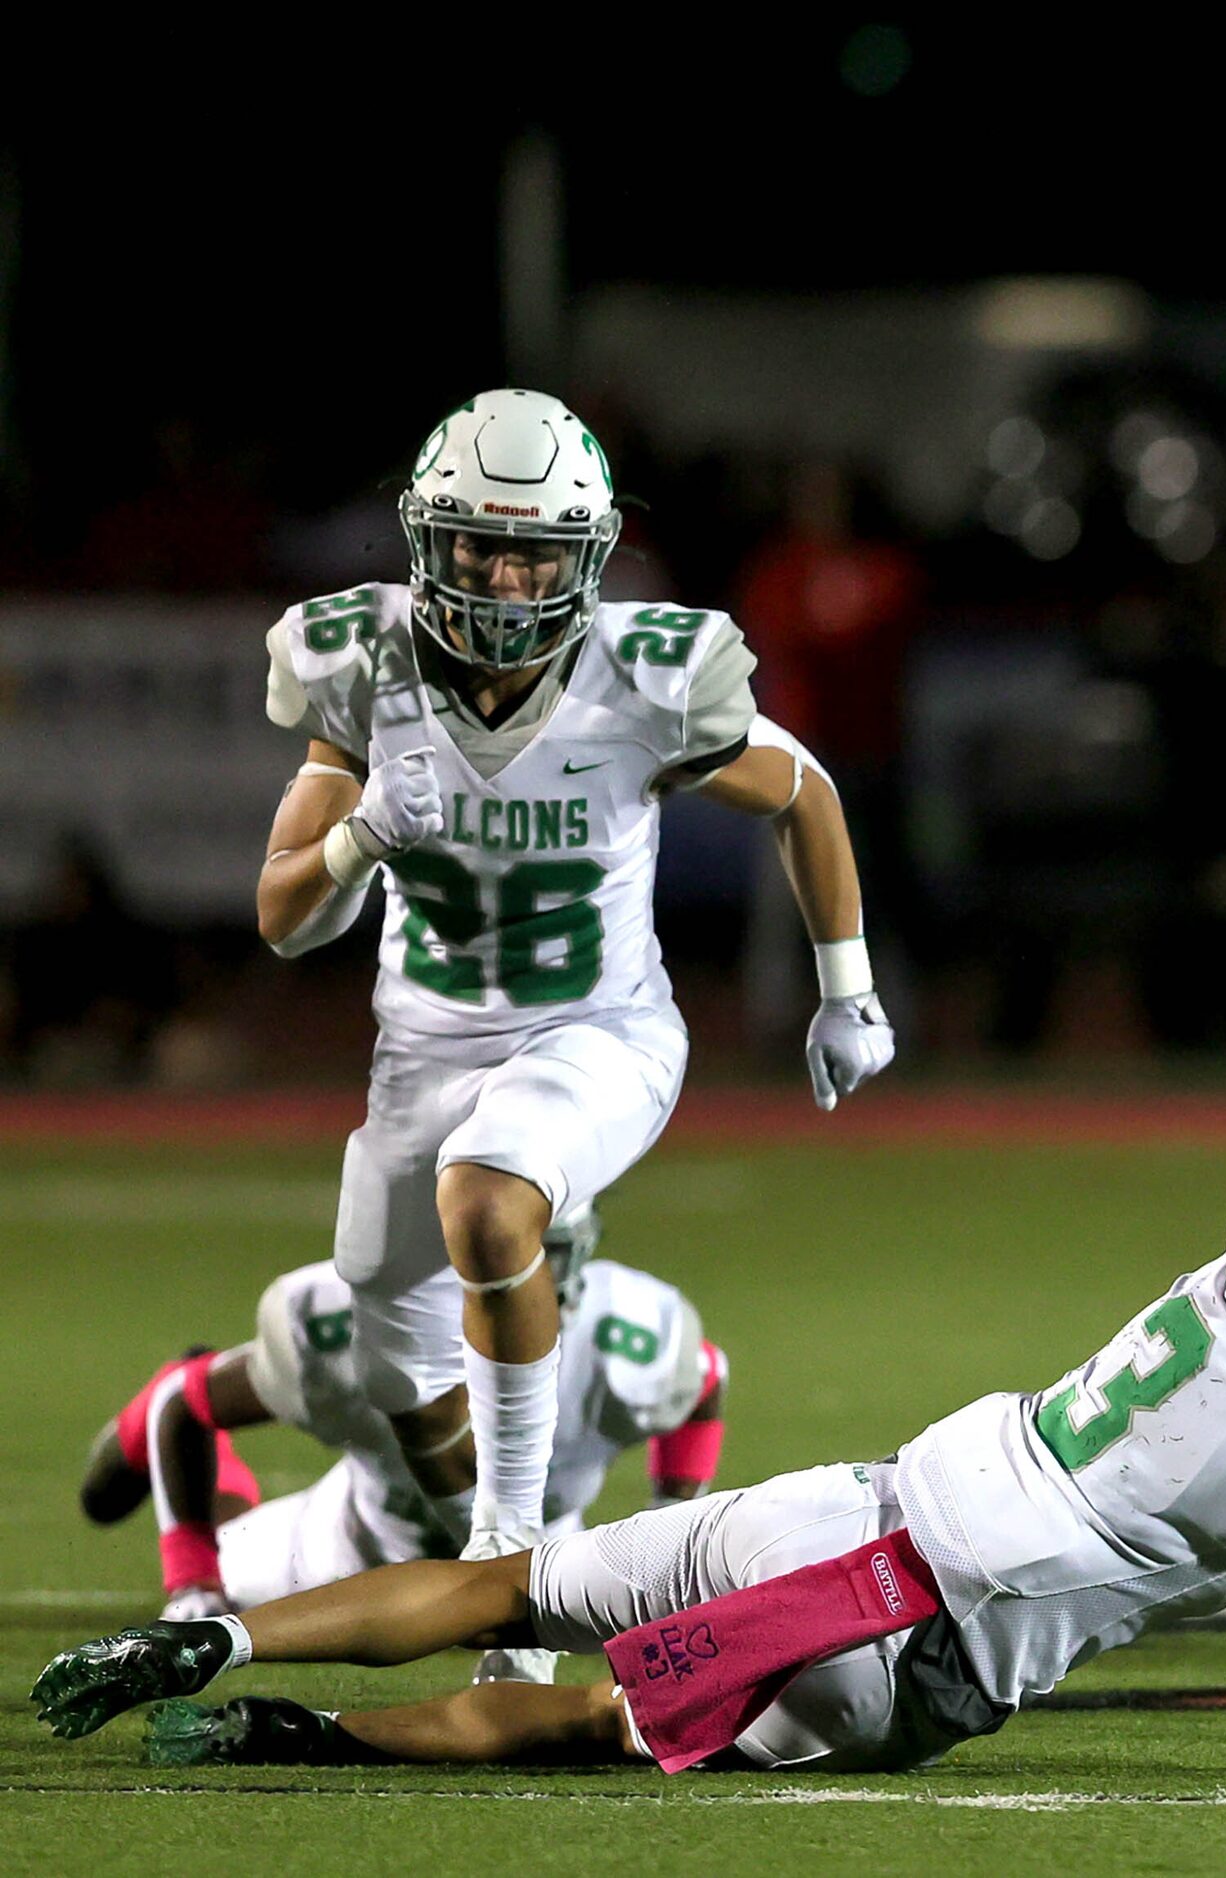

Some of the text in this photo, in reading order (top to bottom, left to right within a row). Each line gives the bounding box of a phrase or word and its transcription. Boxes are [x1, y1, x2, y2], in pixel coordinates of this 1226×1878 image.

[618, 606, 710, 669] 26
[436, 792, 589, 851] LCONS
[399, 848, 605, 1008] 26
[594, 1315, 659, 1365] 8
[1035, 1293, 1217, 1473] 3
[874, 1557, 903, 1613] BATTLE
